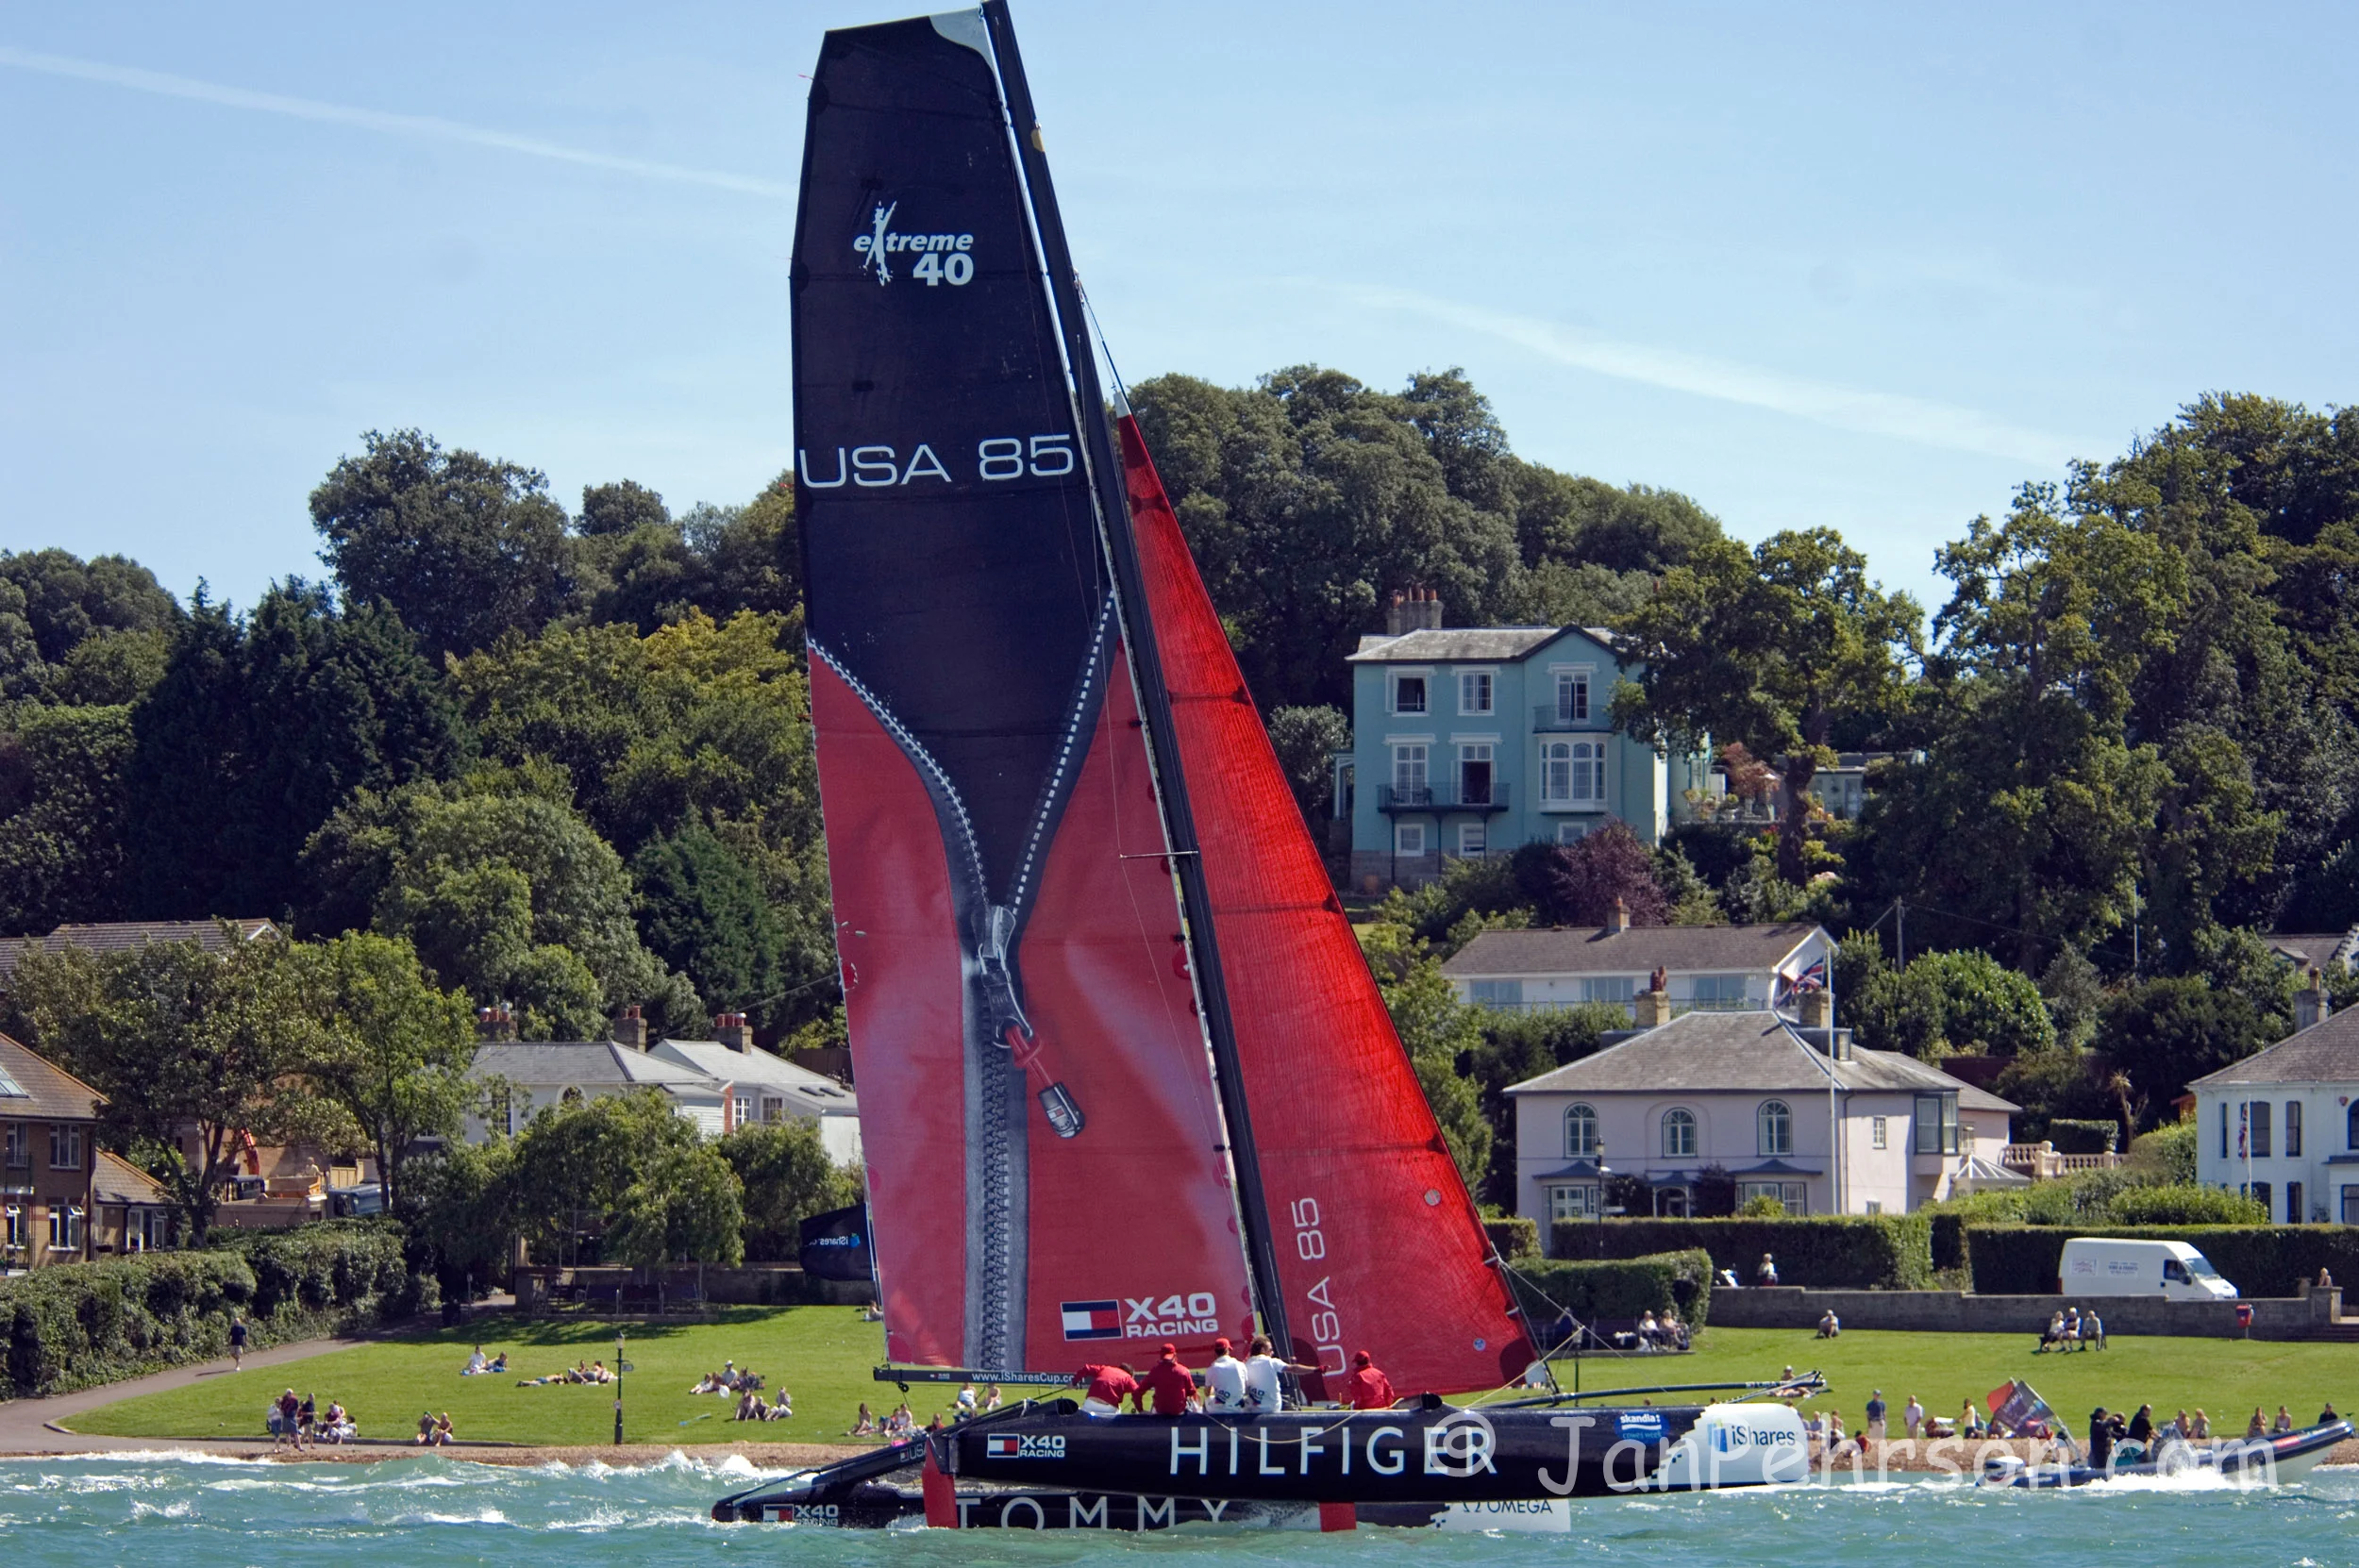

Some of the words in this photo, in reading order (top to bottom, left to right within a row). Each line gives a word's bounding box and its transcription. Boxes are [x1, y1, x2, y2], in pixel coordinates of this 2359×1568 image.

[912, 253, 974, 287] 40
[799, 444, 952, 488] USA
[978, 434, 1074, 480] 85
[1291, 1197, 1326, 1260] 85
[1124, 1292, 1217, 1323] X40
[1126, 1318, 1219, 1338] RACING
[1307, 1276, 1347, 1376] USA
[1020, 1435, 1065, 1450] X40
[1169, 1426, 1497, 1475] HILFIGER
[1731, 1425, 1796, 1446] iShares
[1019, 1449, 1065, 1459] RACING
[795, 1504, 839, 1518] X40
[956, 1495, 1230, 1532] TOMMY
[1486, 1498, 1553, 1514] OMEGA
